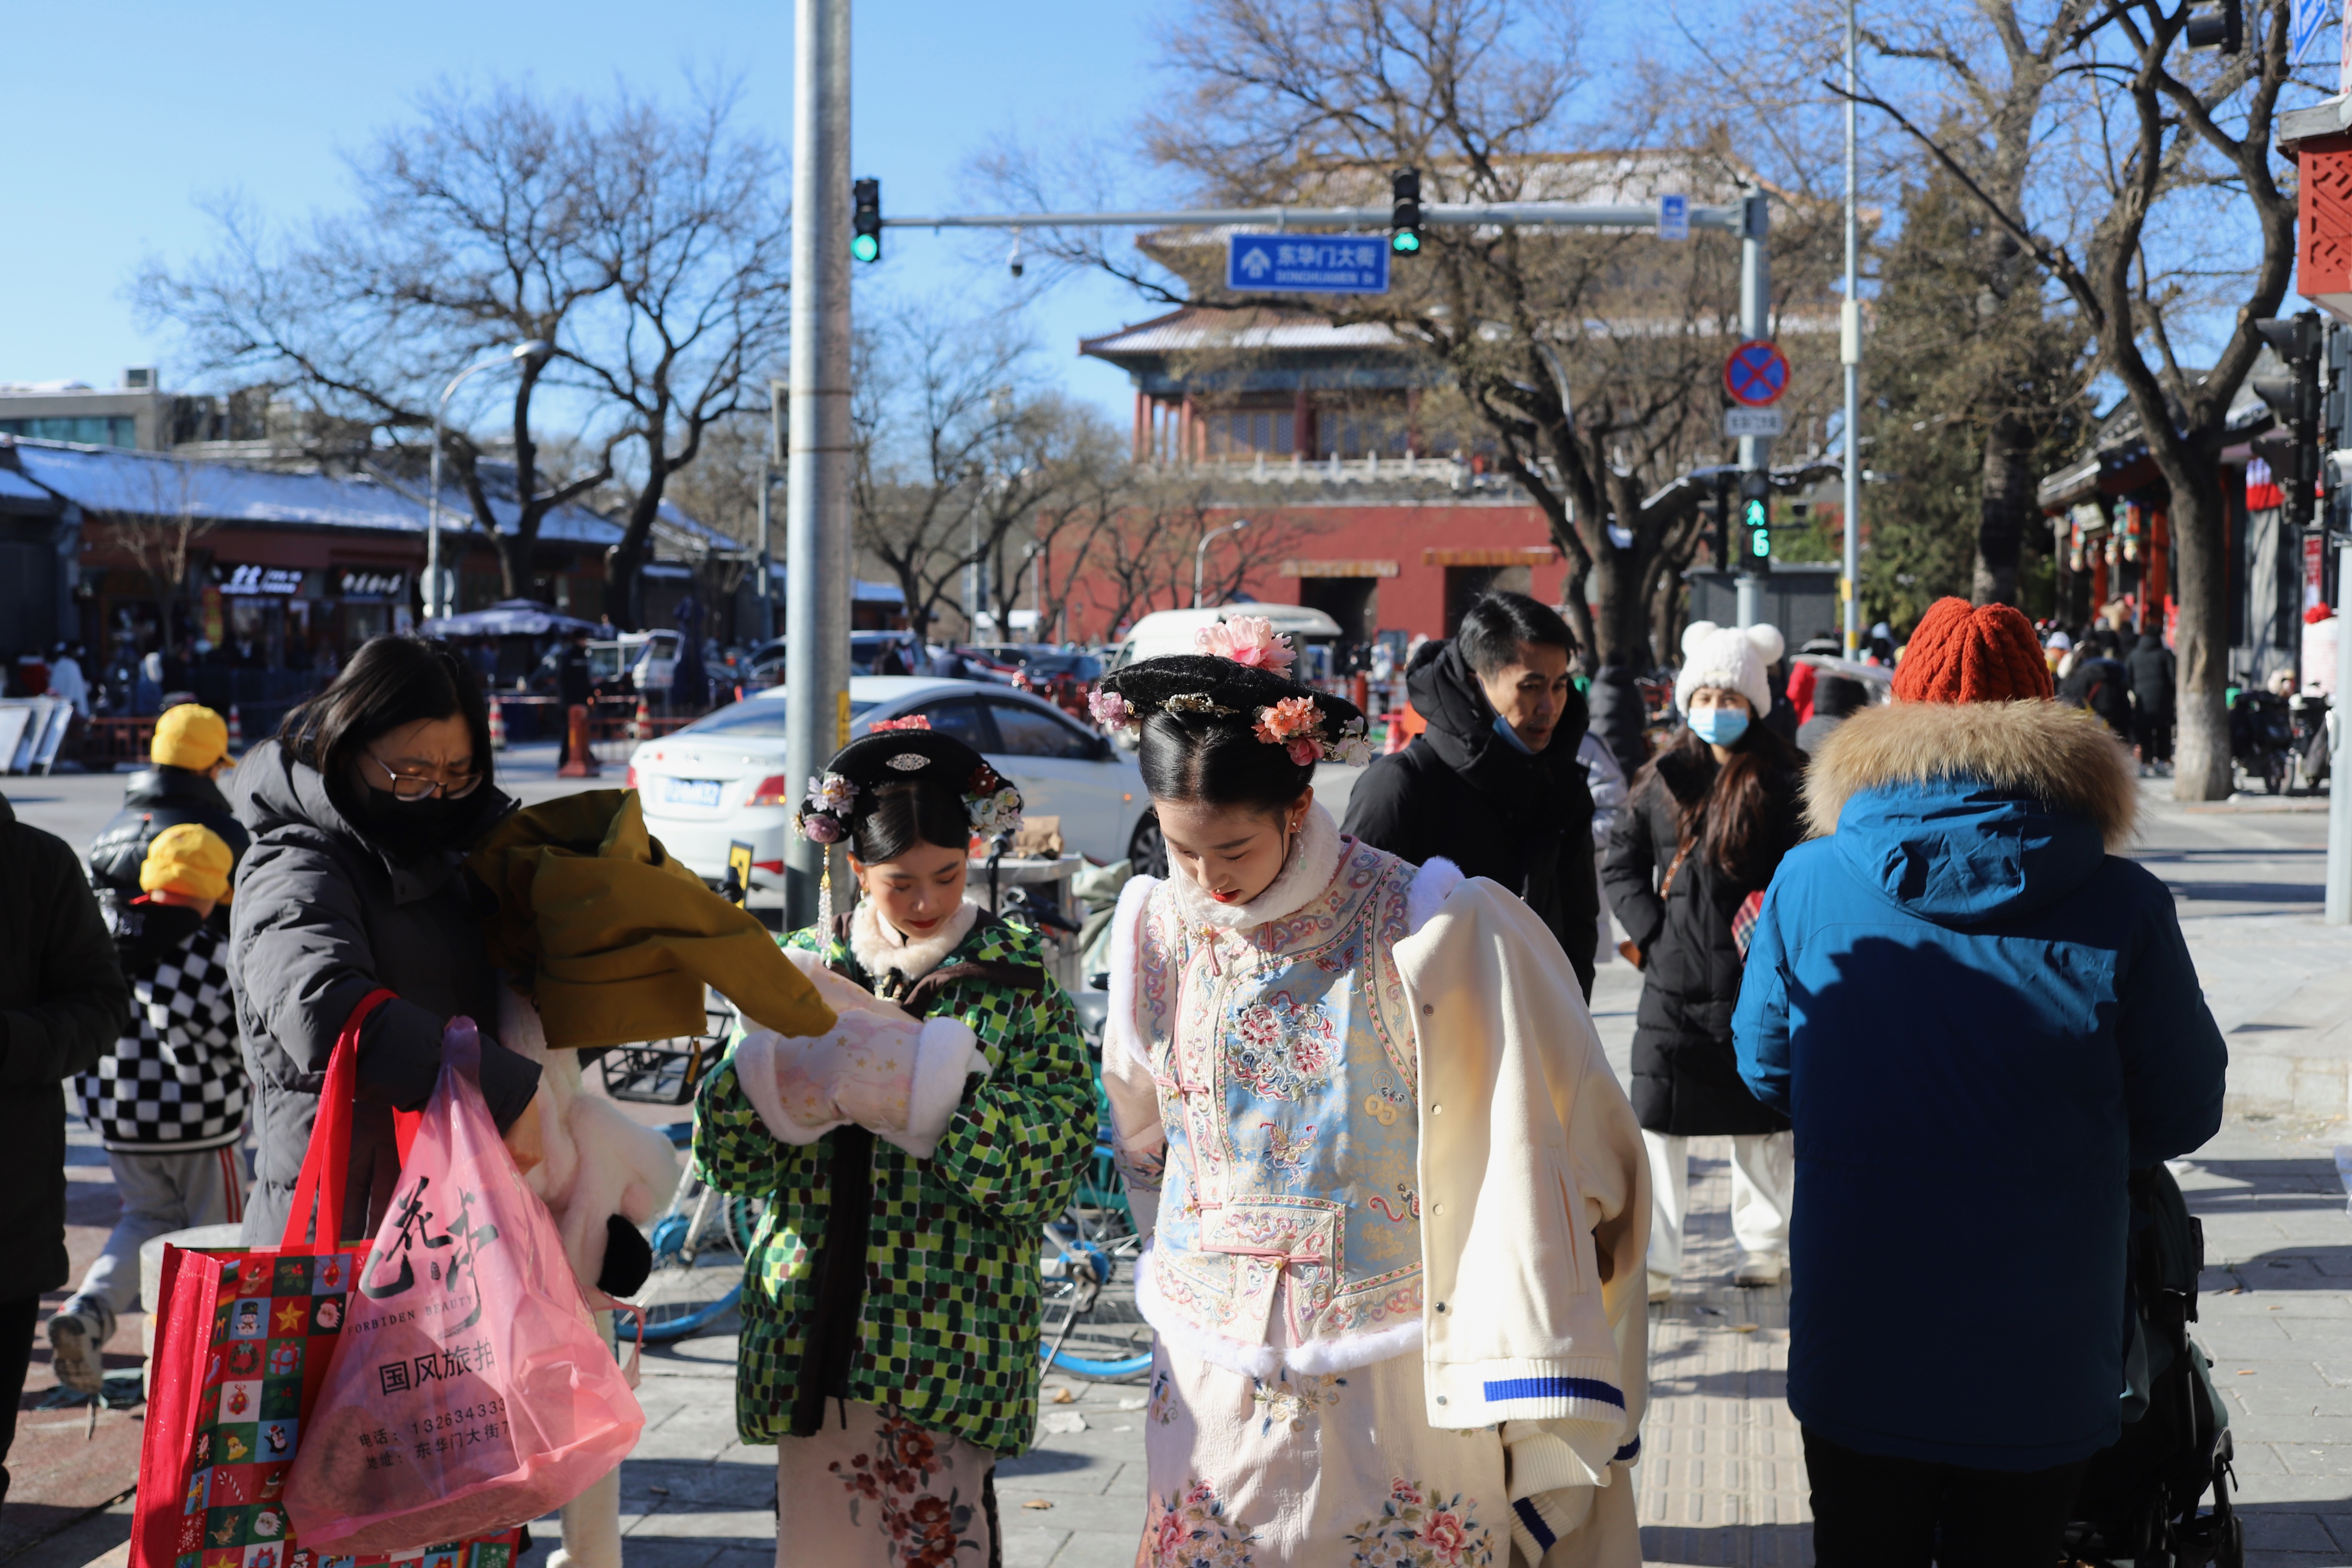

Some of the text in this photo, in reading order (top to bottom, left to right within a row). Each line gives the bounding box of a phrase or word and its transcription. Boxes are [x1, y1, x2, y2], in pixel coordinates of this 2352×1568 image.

[1277, 244, 1375, 268] 东华门大街
[1753, 529, 1769, 557] 6
[348, 1295, 472, 1335] FORBIDEN BEAUTY
[378, 1337, 495, 1396] 国风旅拍
[412, 1398, 505, 1434] 132634333
